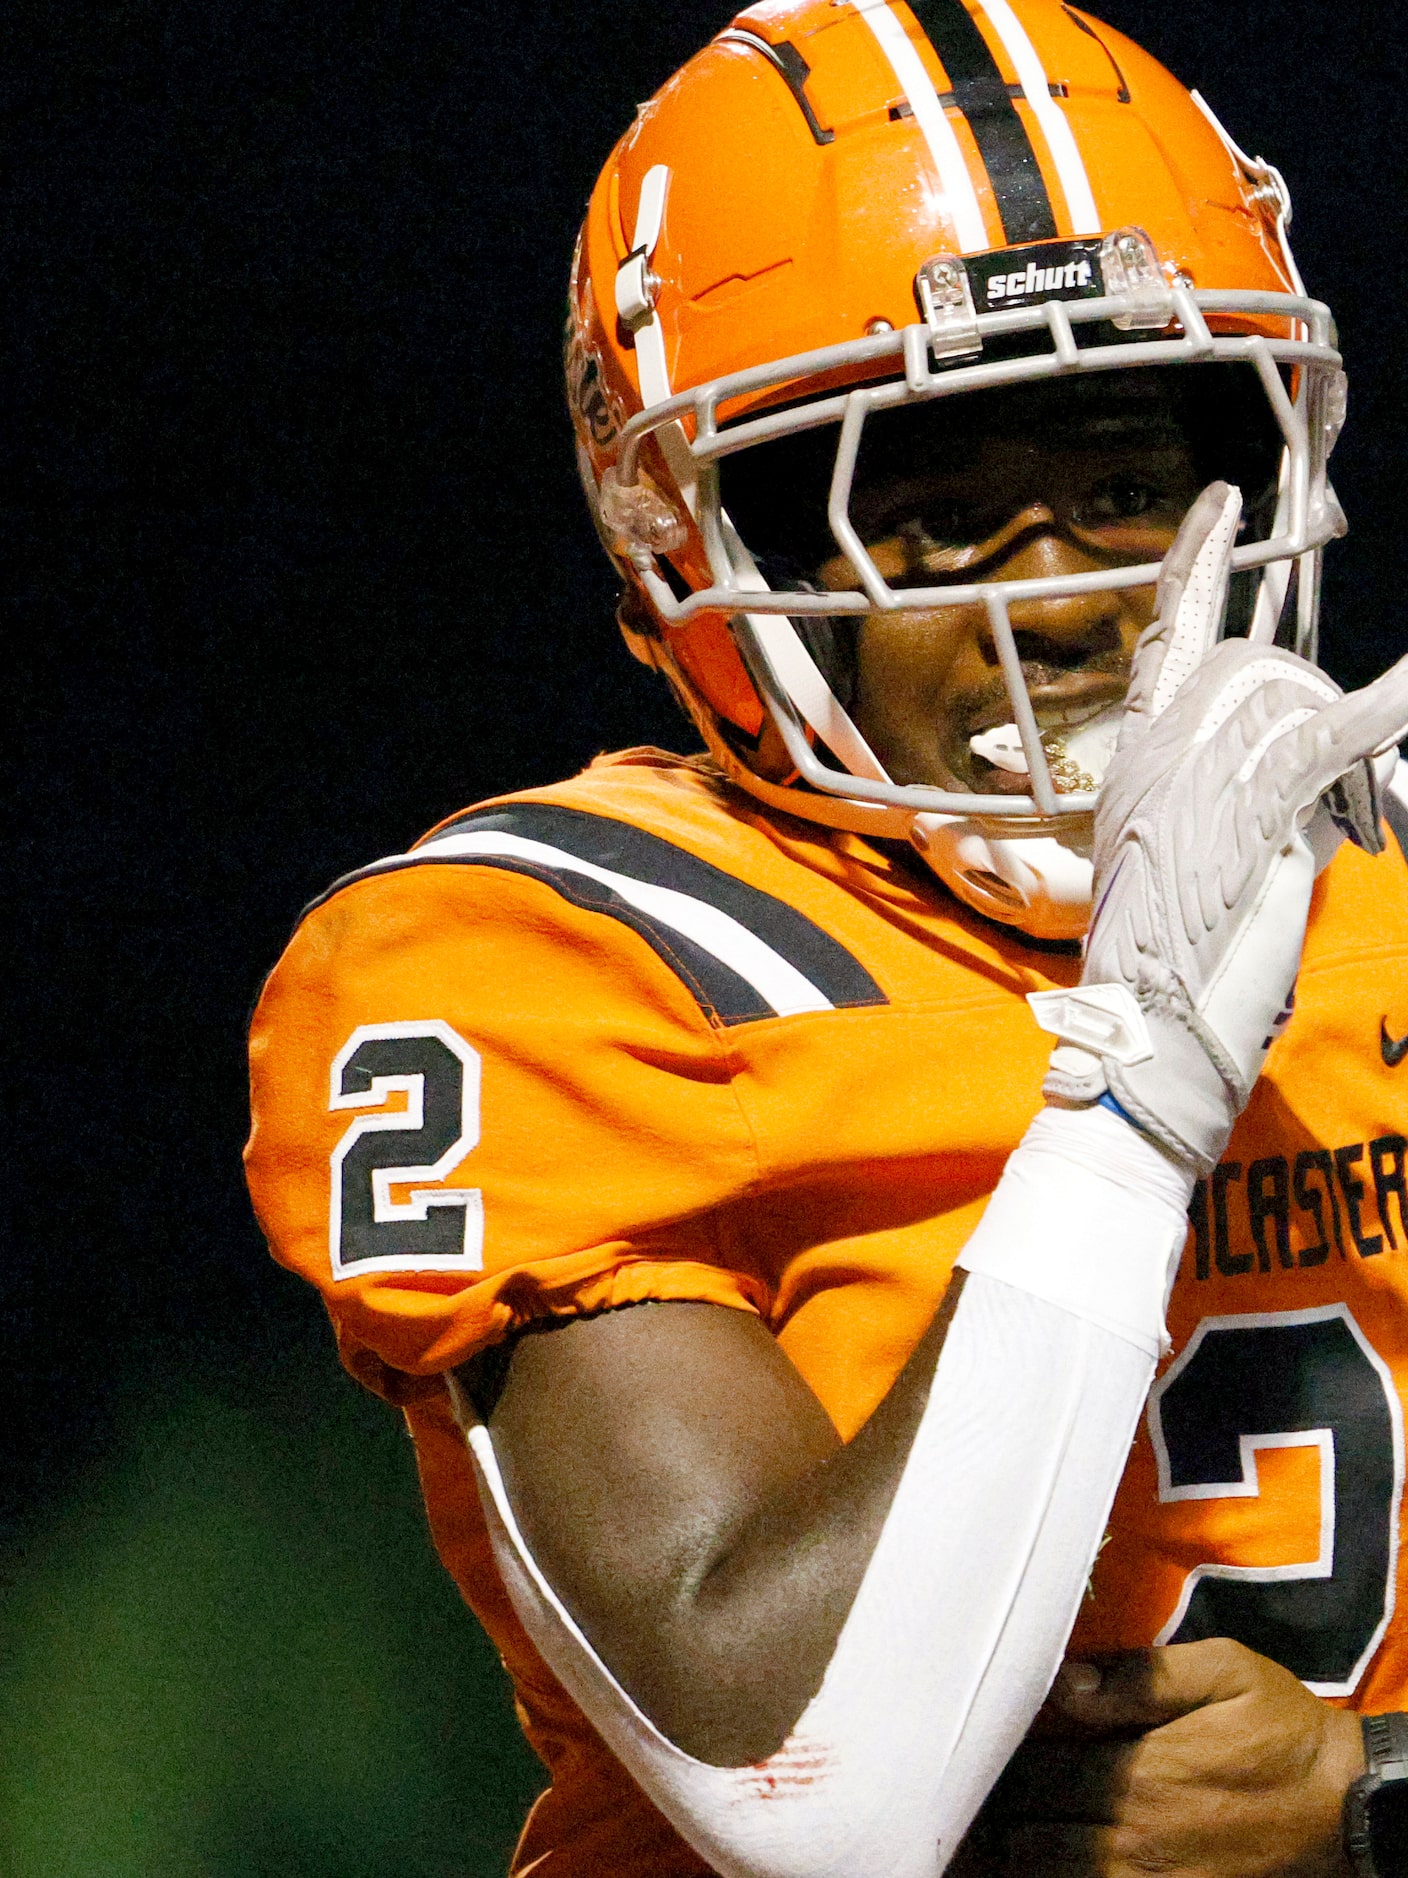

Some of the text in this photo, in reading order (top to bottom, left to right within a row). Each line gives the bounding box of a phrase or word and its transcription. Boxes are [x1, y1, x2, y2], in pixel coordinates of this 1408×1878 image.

[986, 260, 1093, 300] schutt
[328, 1018, 484, 1282] 2
[1146, 1301, 1406, 1697] 2
